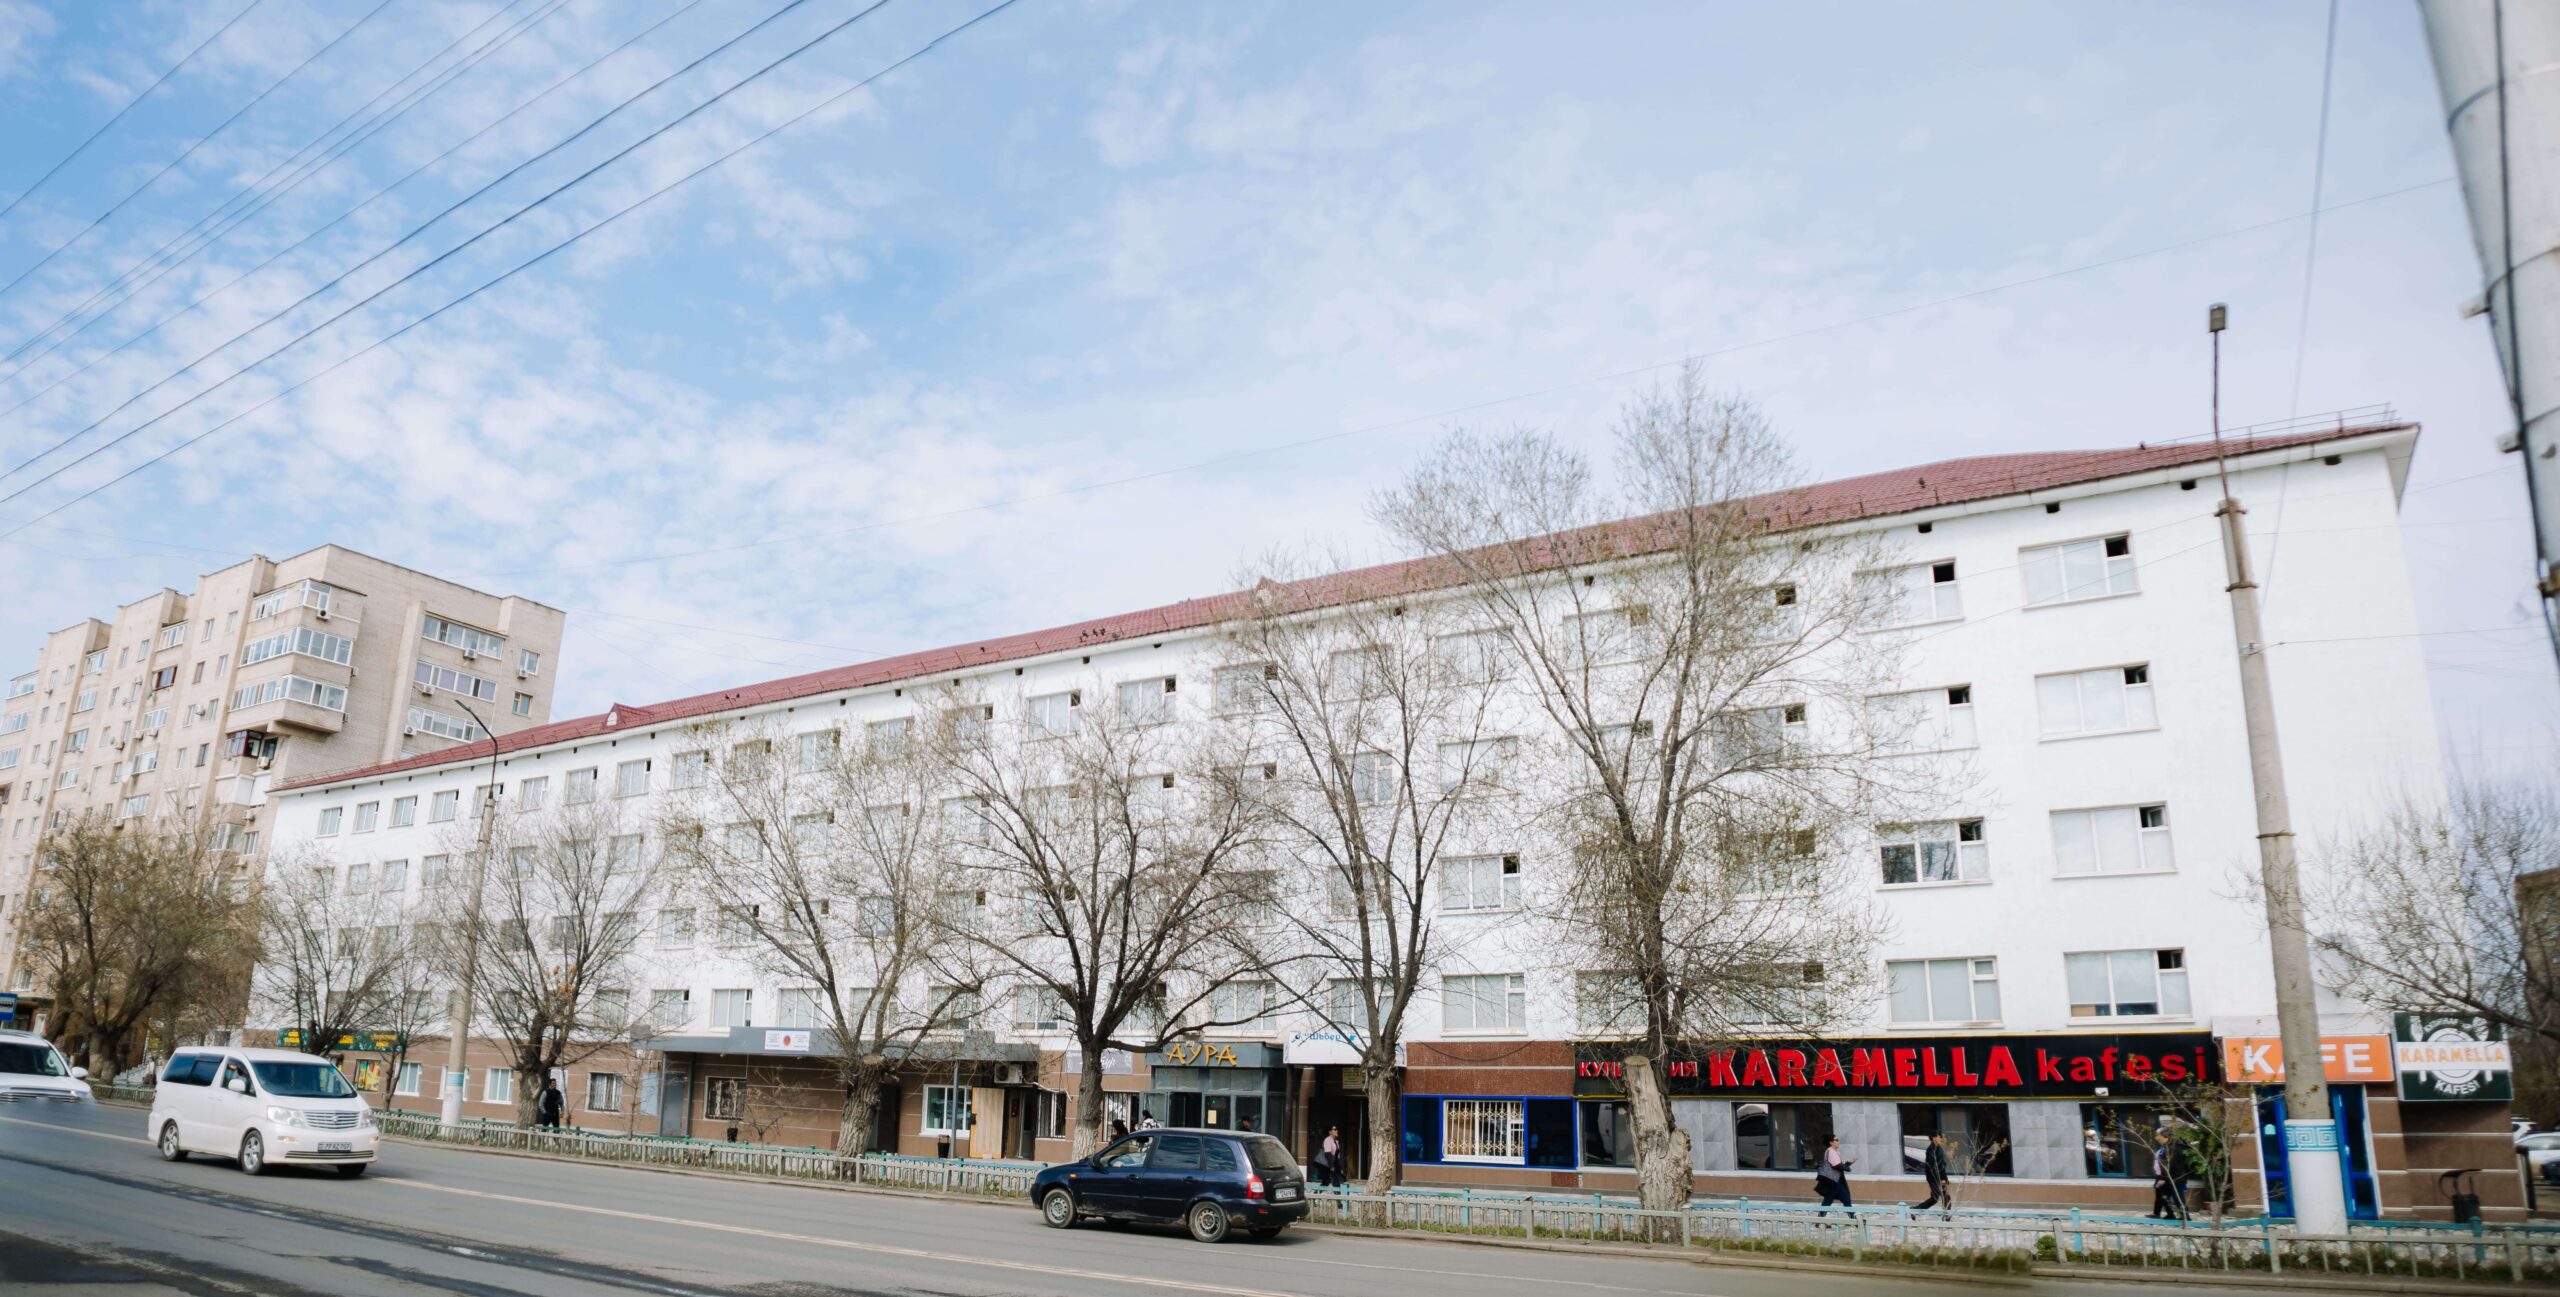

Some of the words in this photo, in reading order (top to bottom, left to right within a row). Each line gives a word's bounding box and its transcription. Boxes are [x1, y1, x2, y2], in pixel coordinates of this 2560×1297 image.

[1167, 1043, 1238, 1066] АУРА
[2244, 1043, 2374, 1074] KFE
[2400, 1045, 2505, 1064] KARAMELLA
[1709, 1047, 2023, 1086] KARAMELLA
[2036, 1047, 2207, 1082] kafesi
[2434, 1079, 2481, 1095] KAFESI
